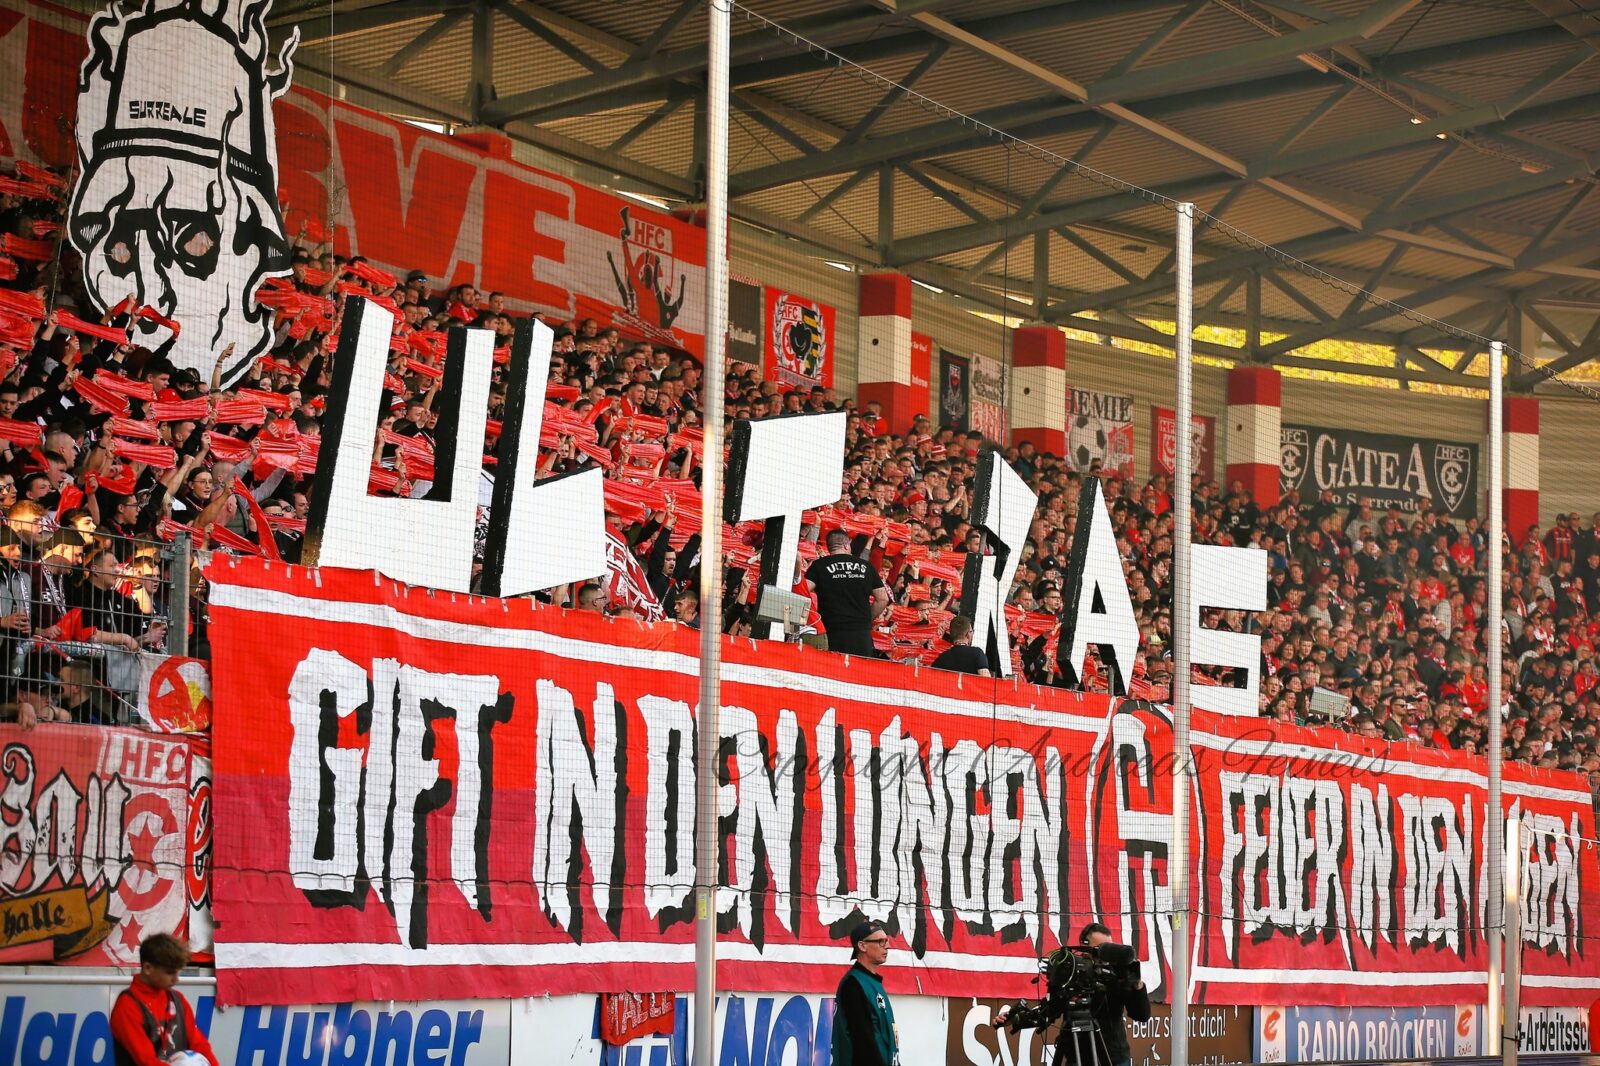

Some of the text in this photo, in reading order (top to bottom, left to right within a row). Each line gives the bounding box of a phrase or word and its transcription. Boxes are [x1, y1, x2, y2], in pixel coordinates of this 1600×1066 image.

[129, 100, 208, 128] SURREALE
[635, 220, 666, 250] HFC
[1441, 447, 1465, 460] HFC
[826, 561, 868, 574] ULTRAS
[121, 735, 187, 781] HFC
[1199, 1008, 1227, 1038] dich!
[1297, 1019, 1360, 1062] RADIO
